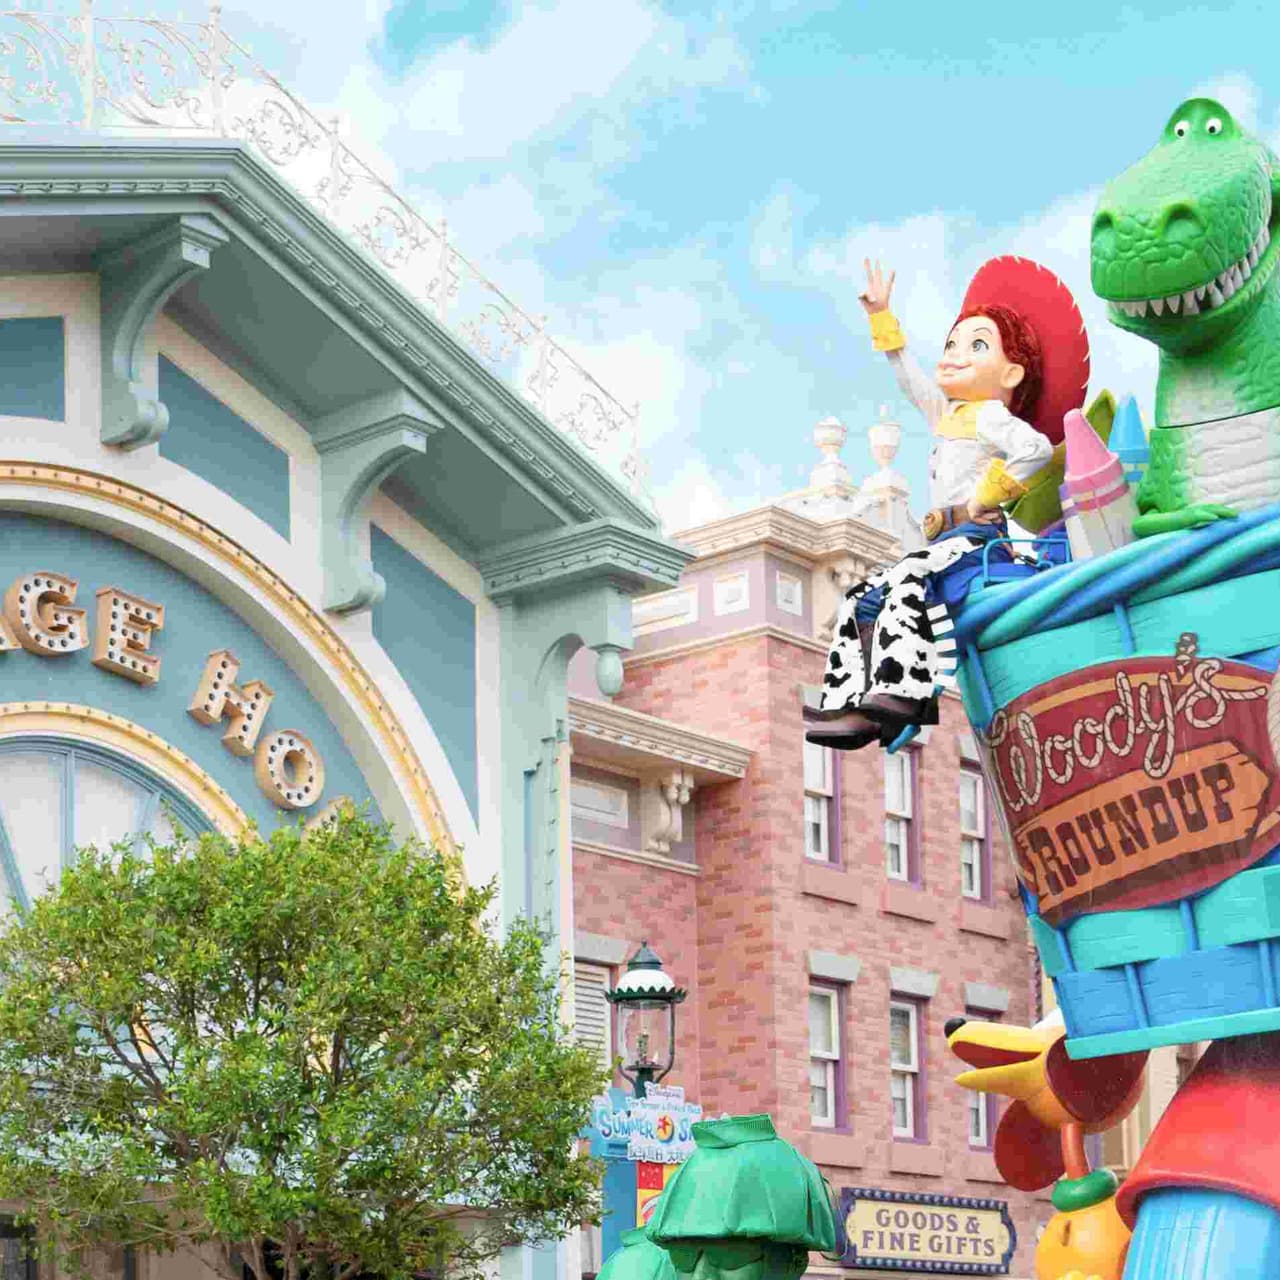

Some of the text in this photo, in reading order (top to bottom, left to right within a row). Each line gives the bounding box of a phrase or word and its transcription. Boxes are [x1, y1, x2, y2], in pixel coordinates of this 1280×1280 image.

[984, 634, 1269, 813] Woody's
[1025, 762, 1235, 897] ROUNDUP
[862, 1230, 996, 1257] FINE GIFTS
[875, 1208, 981, 1234] GOODS &
